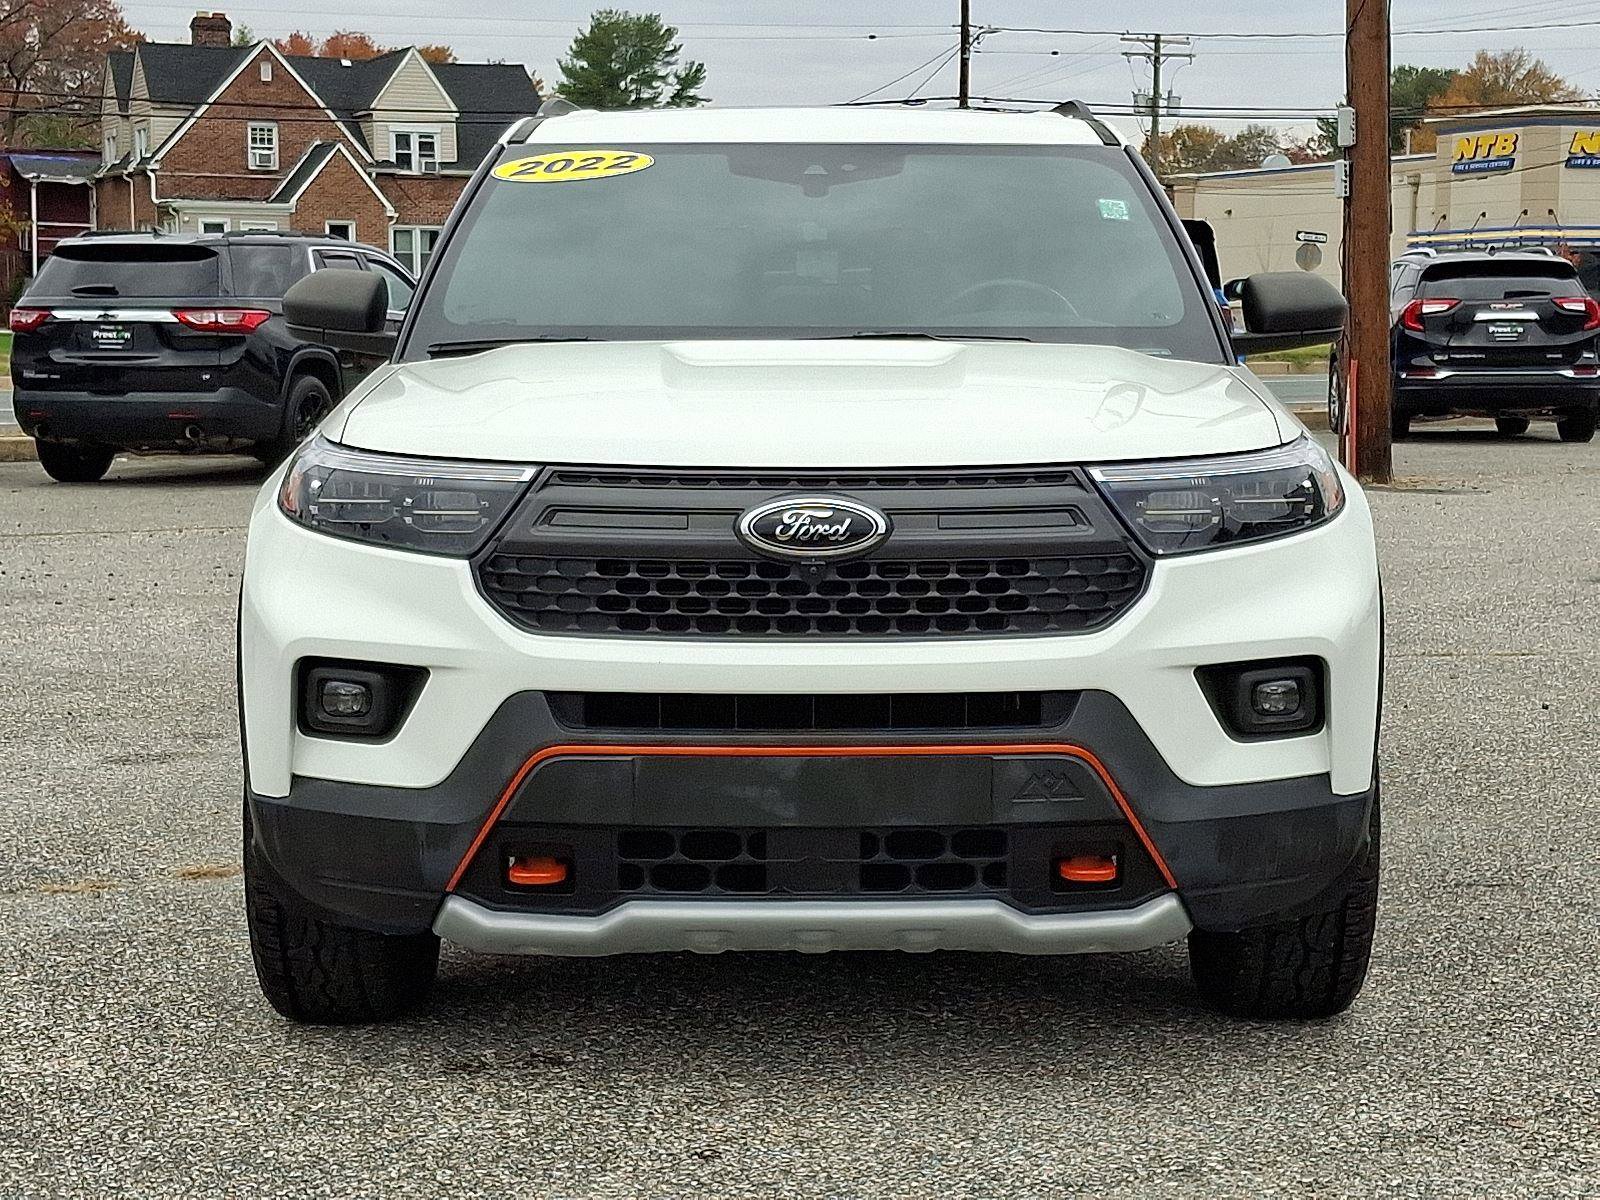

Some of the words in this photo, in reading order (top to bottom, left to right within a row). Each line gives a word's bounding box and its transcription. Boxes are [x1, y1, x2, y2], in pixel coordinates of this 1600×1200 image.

[1453, 133, 1518, 161] NTB
[1569, 131, 1600, 155] N
[509, 155, 639, 177] 2022
[775, 509, 852, 541] Ford
